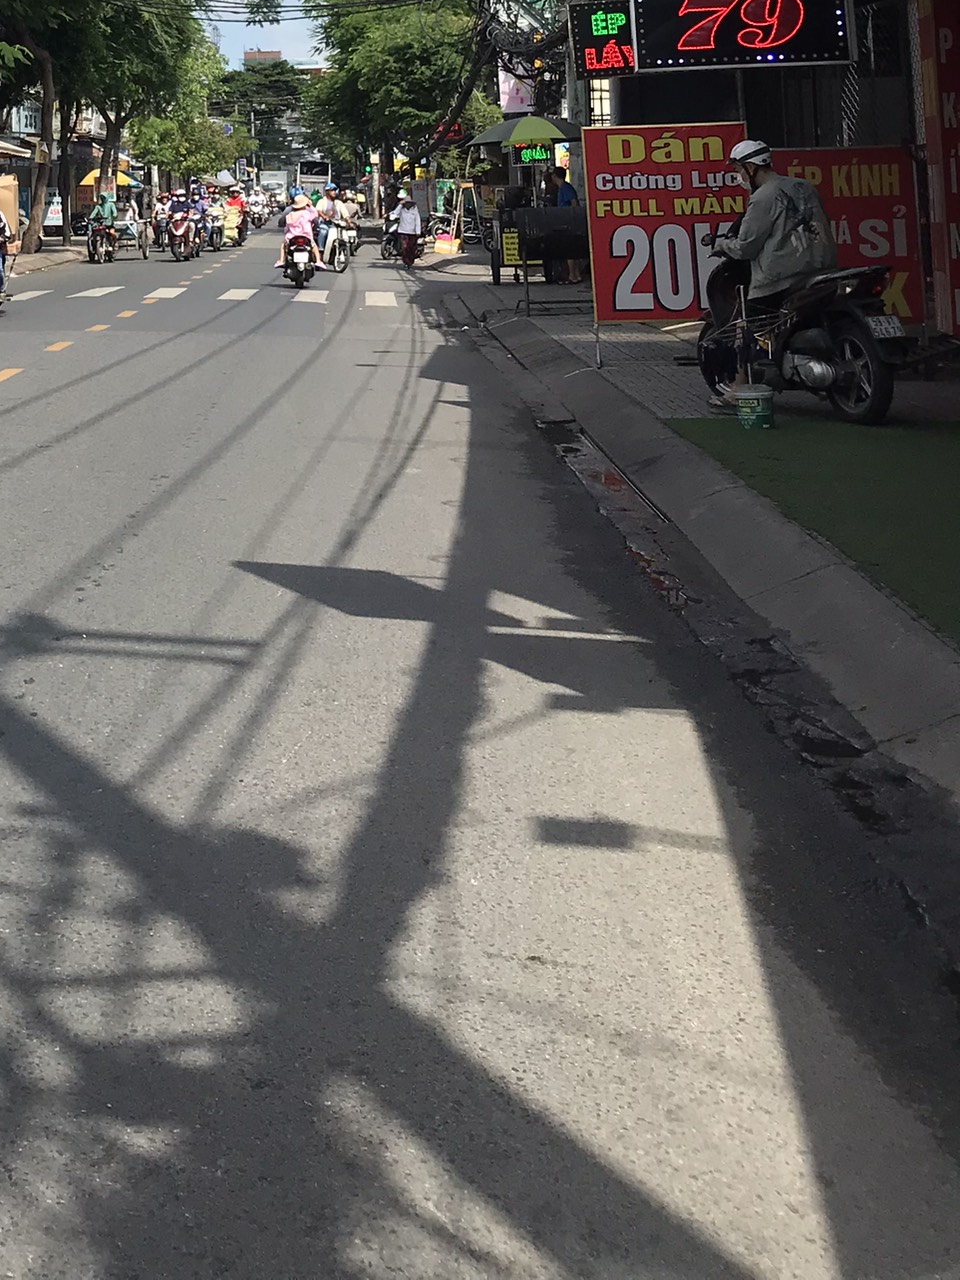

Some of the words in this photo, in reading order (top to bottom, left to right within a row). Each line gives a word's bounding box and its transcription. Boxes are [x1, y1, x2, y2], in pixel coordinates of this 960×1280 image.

[591, 10, 626, 36] ÉP
[607, 134, 724, 165] Dán
[595, 170, 681, 193] Cường
[691, 170, 740, 195] Lực
[831, 158, 901, 198] KÍNH
[596, 198, 671, 218] FULL
[673, 192, 745, 216] MÀN
[858, 204, 908, 259] SỈ
